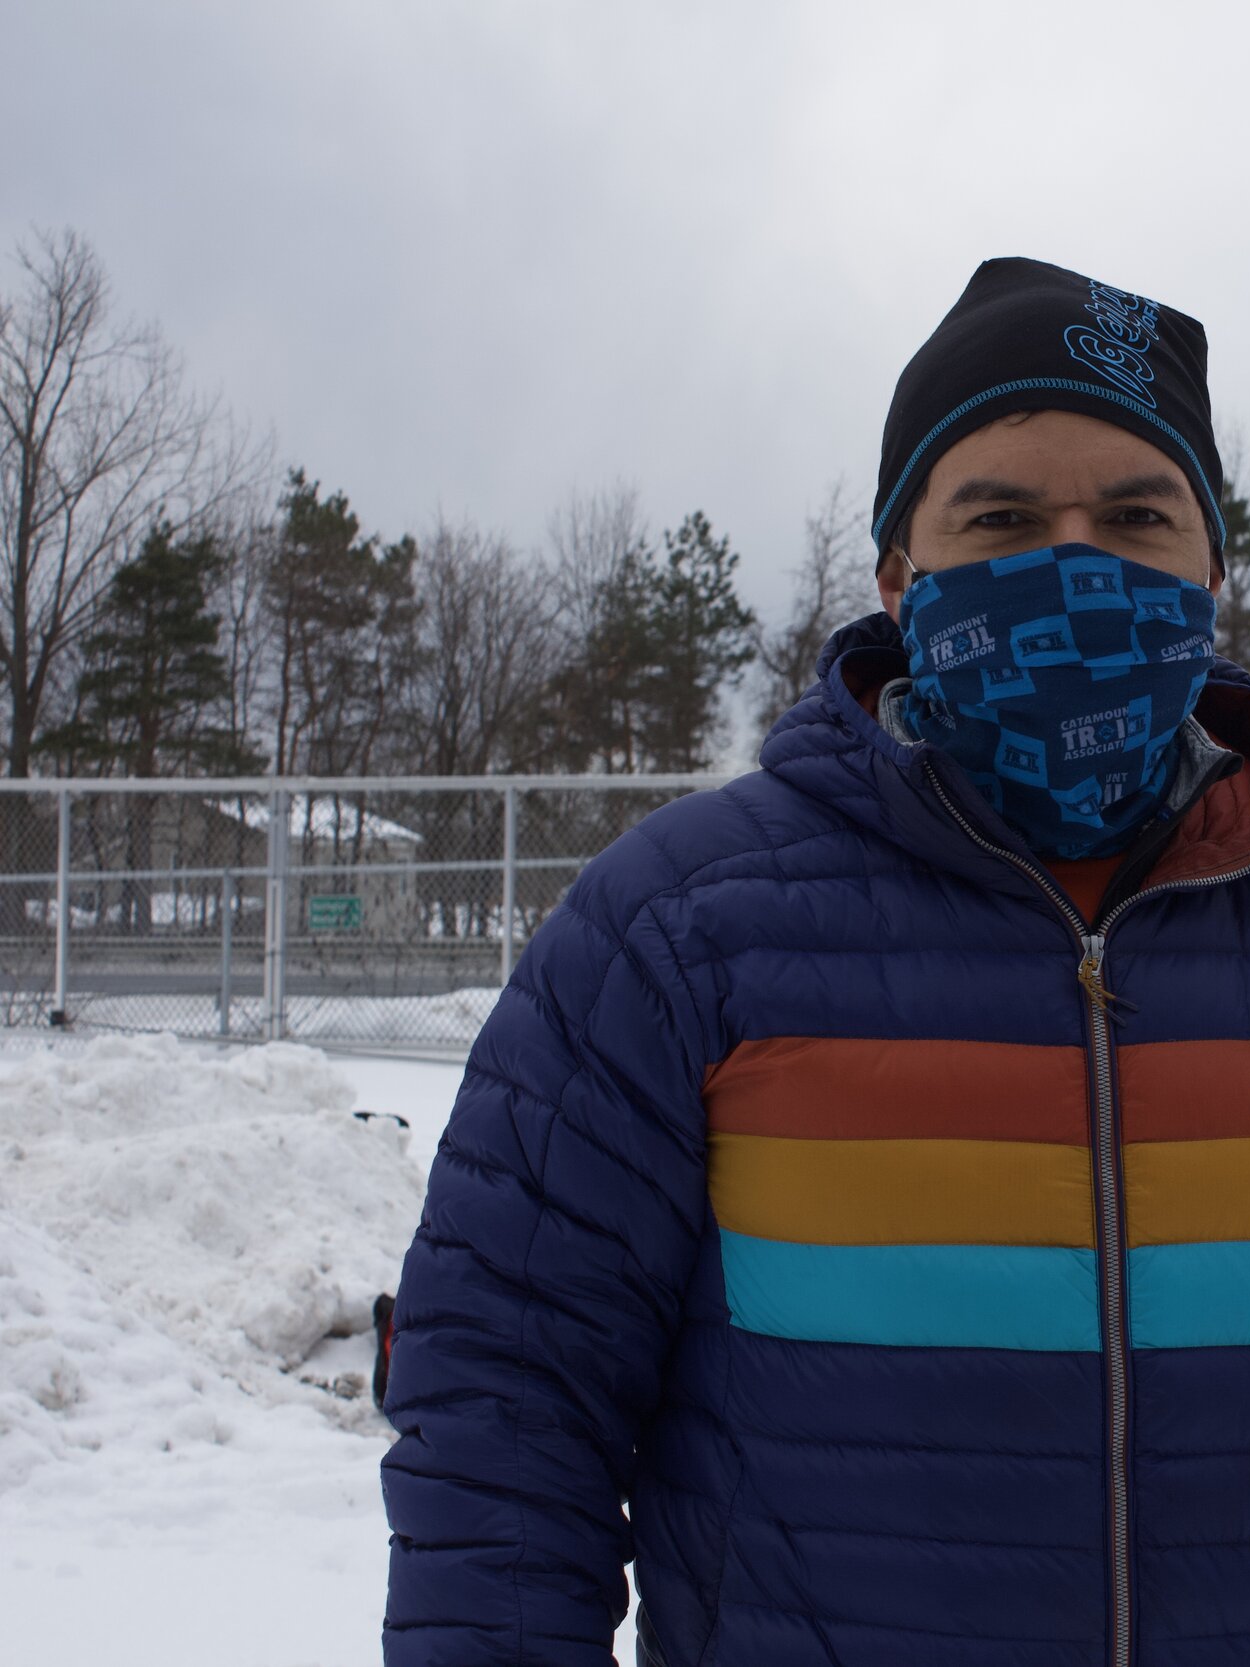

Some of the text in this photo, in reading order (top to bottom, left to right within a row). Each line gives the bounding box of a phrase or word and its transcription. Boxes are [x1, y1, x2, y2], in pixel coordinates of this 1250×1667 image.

[929, 613, 988, 646] CATAMOUNT
[1160, 633, 1206, 657] CATAMOU
[935, 644, 996, 673] ASSOCIATION
[1061, 718, 1128, 751] TRI
